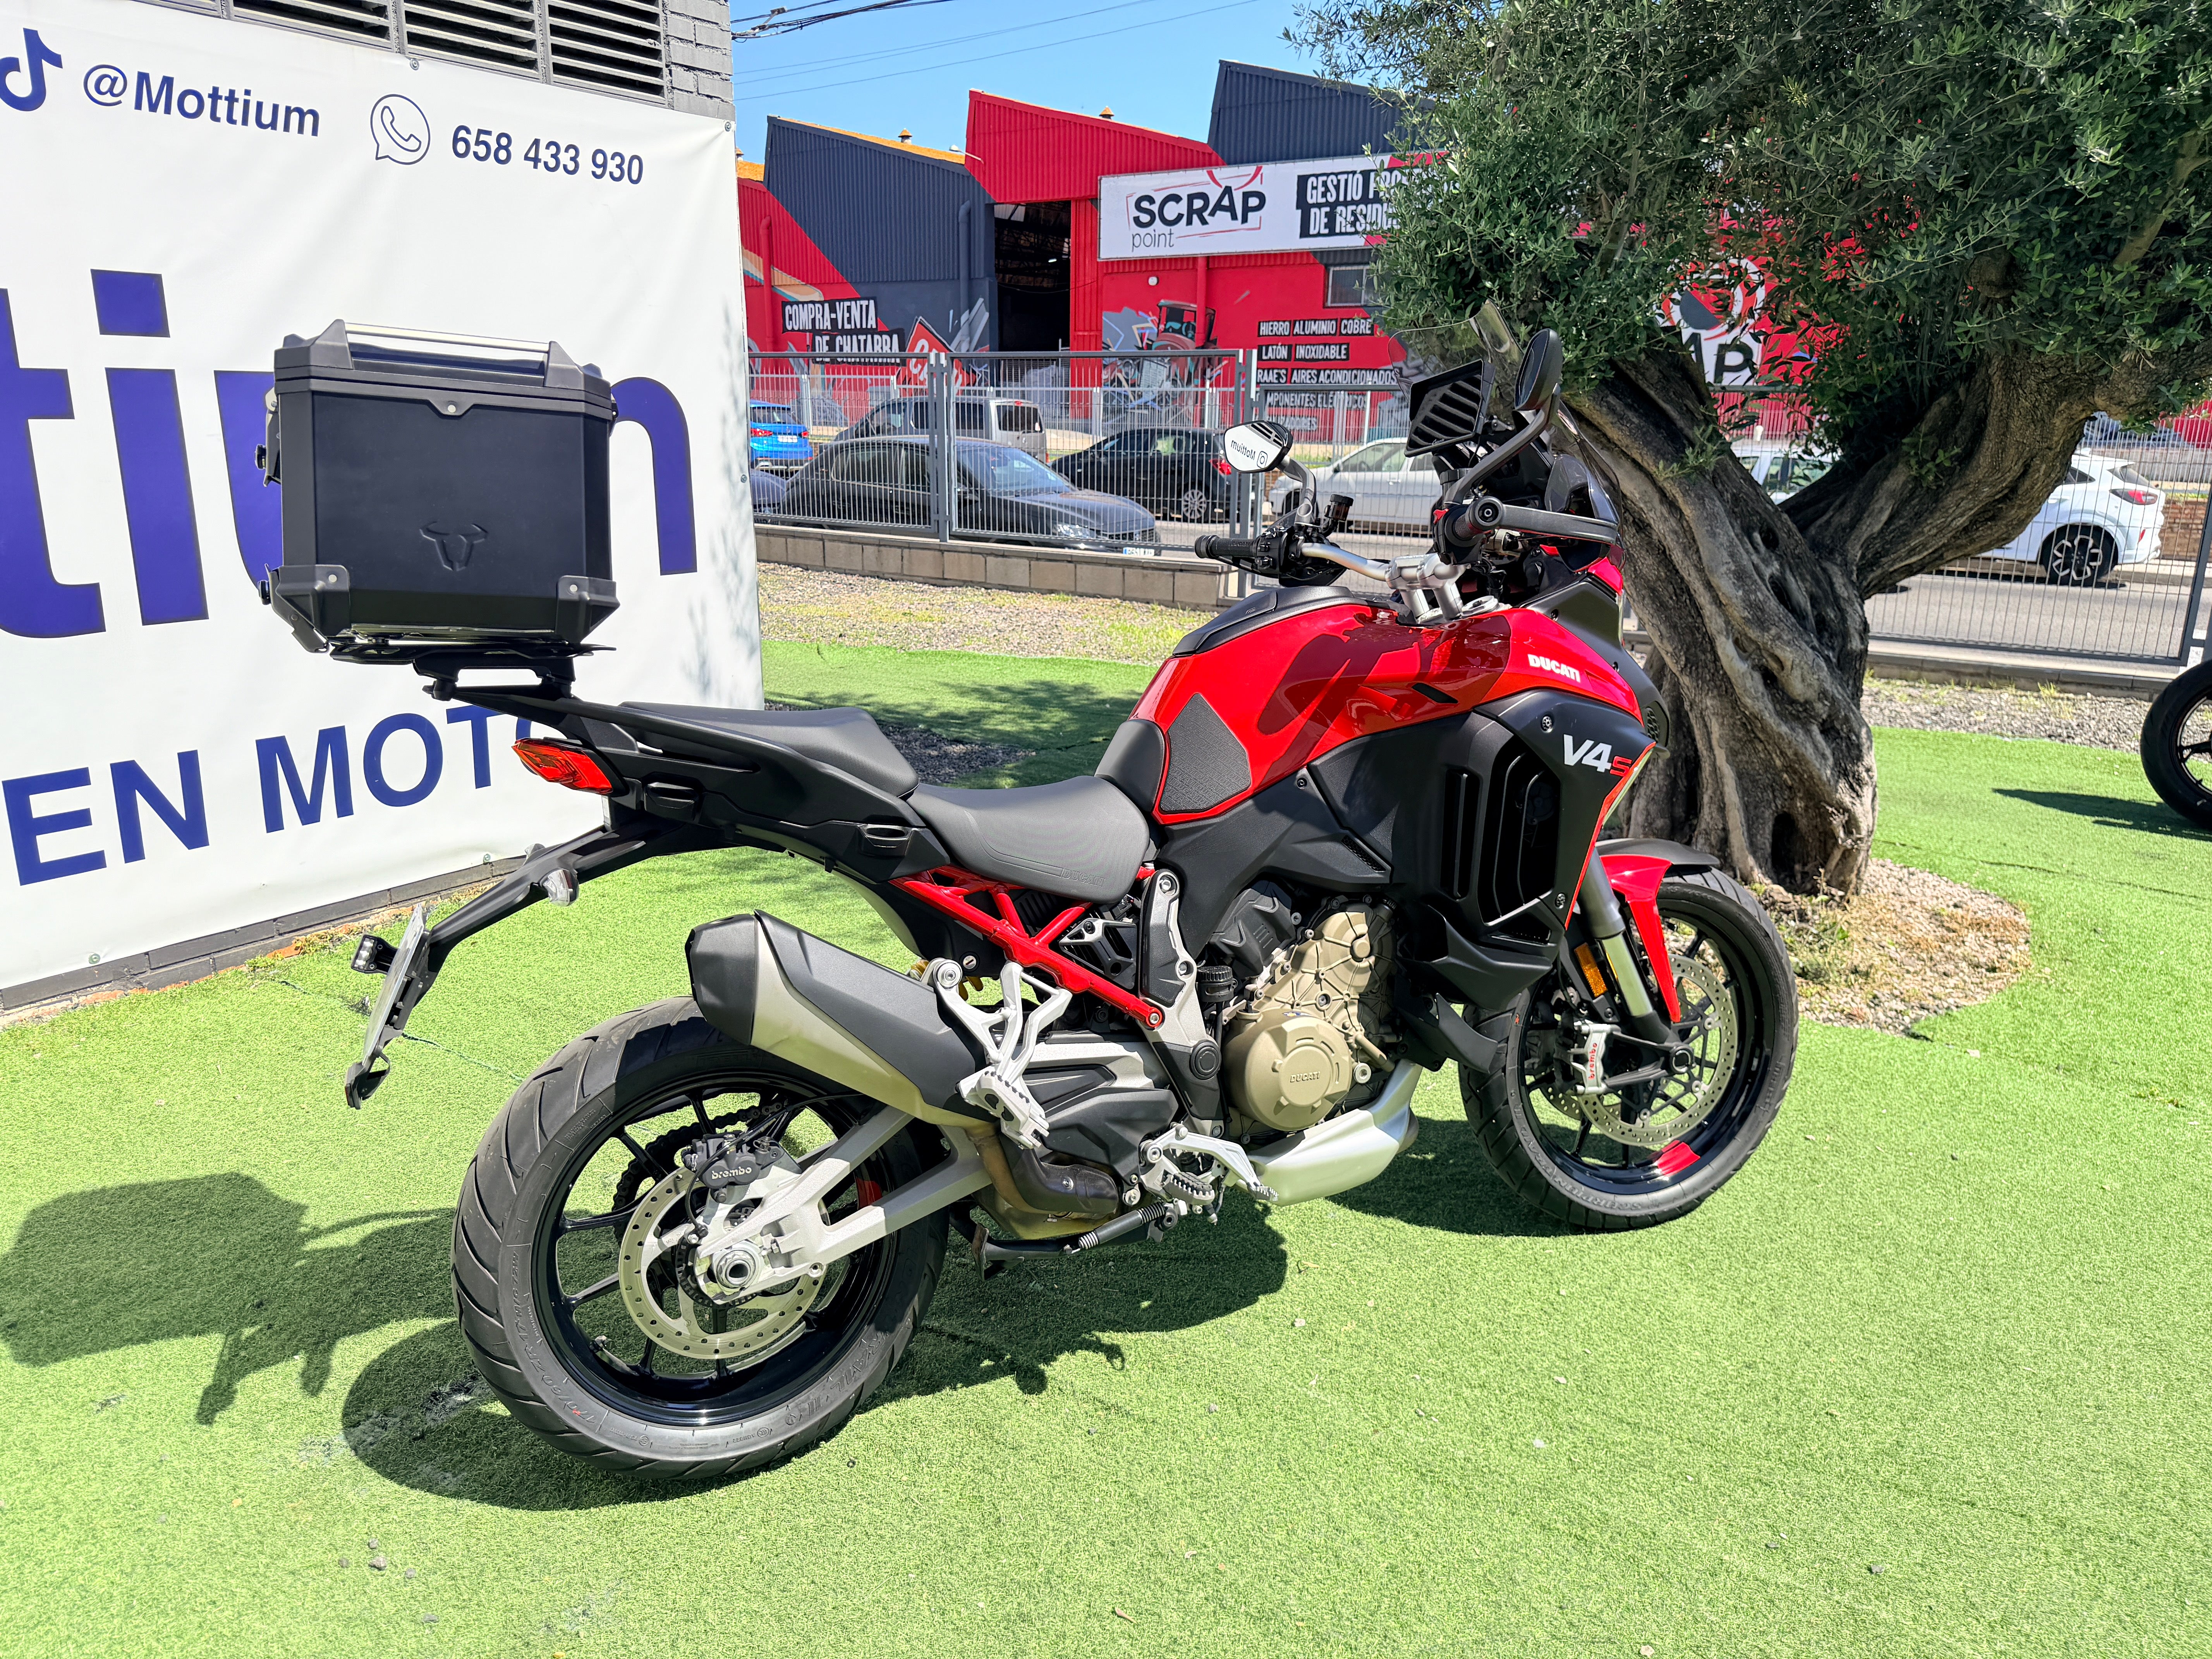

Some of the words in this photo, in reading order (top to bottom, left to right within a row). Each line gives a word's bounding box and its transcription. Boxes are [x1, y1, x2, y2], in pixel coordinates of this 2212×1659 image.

[83, 64, 320, 137] @Mottium
[452, 125, 513, 165] 658
[524, 137, 580, 175] 433
[591, 148, 644, 185] 930
[1306, 170, 1364, 204] GESTIÓ
[1133, 185, 1266, 229] SCRAP
[1309, 206, 1331, 235] DE
[1132, 228, 1174, 252] point
[785, 300, 877, 331] COMPRA-VENTA
[1259, 321, 1290, 336] HIERRO
[1293, 319, 1336, 335] ALUMINIO
[1340, 320, 1372, 335] COBRE
[815, 335, 830, 362] DE
[835, 333, 901, 363] CHATARRA
[1262, 342, 1288, 359] LATÓN
[1295, 345, 1347, 359] INOXIDABLE
[1257, 369, 1286, 383] RAAE'S
[1291, 370, 1317, 384] AIRES
[1318, 368, 1400, 385] ACONDICIONADOS
[1527, 654, 1581, 683] DUCATI
[2, 750, 210, 886] EN
[255, 705, 538, 833] MOT
[1061, 868, 1106, 887] DUCATI
[1587, 1042, 1597, 1080] brembo
[1290, 1071, 1321, 1083] DUCATI
[711, 1166, 752, 1180] brembo
